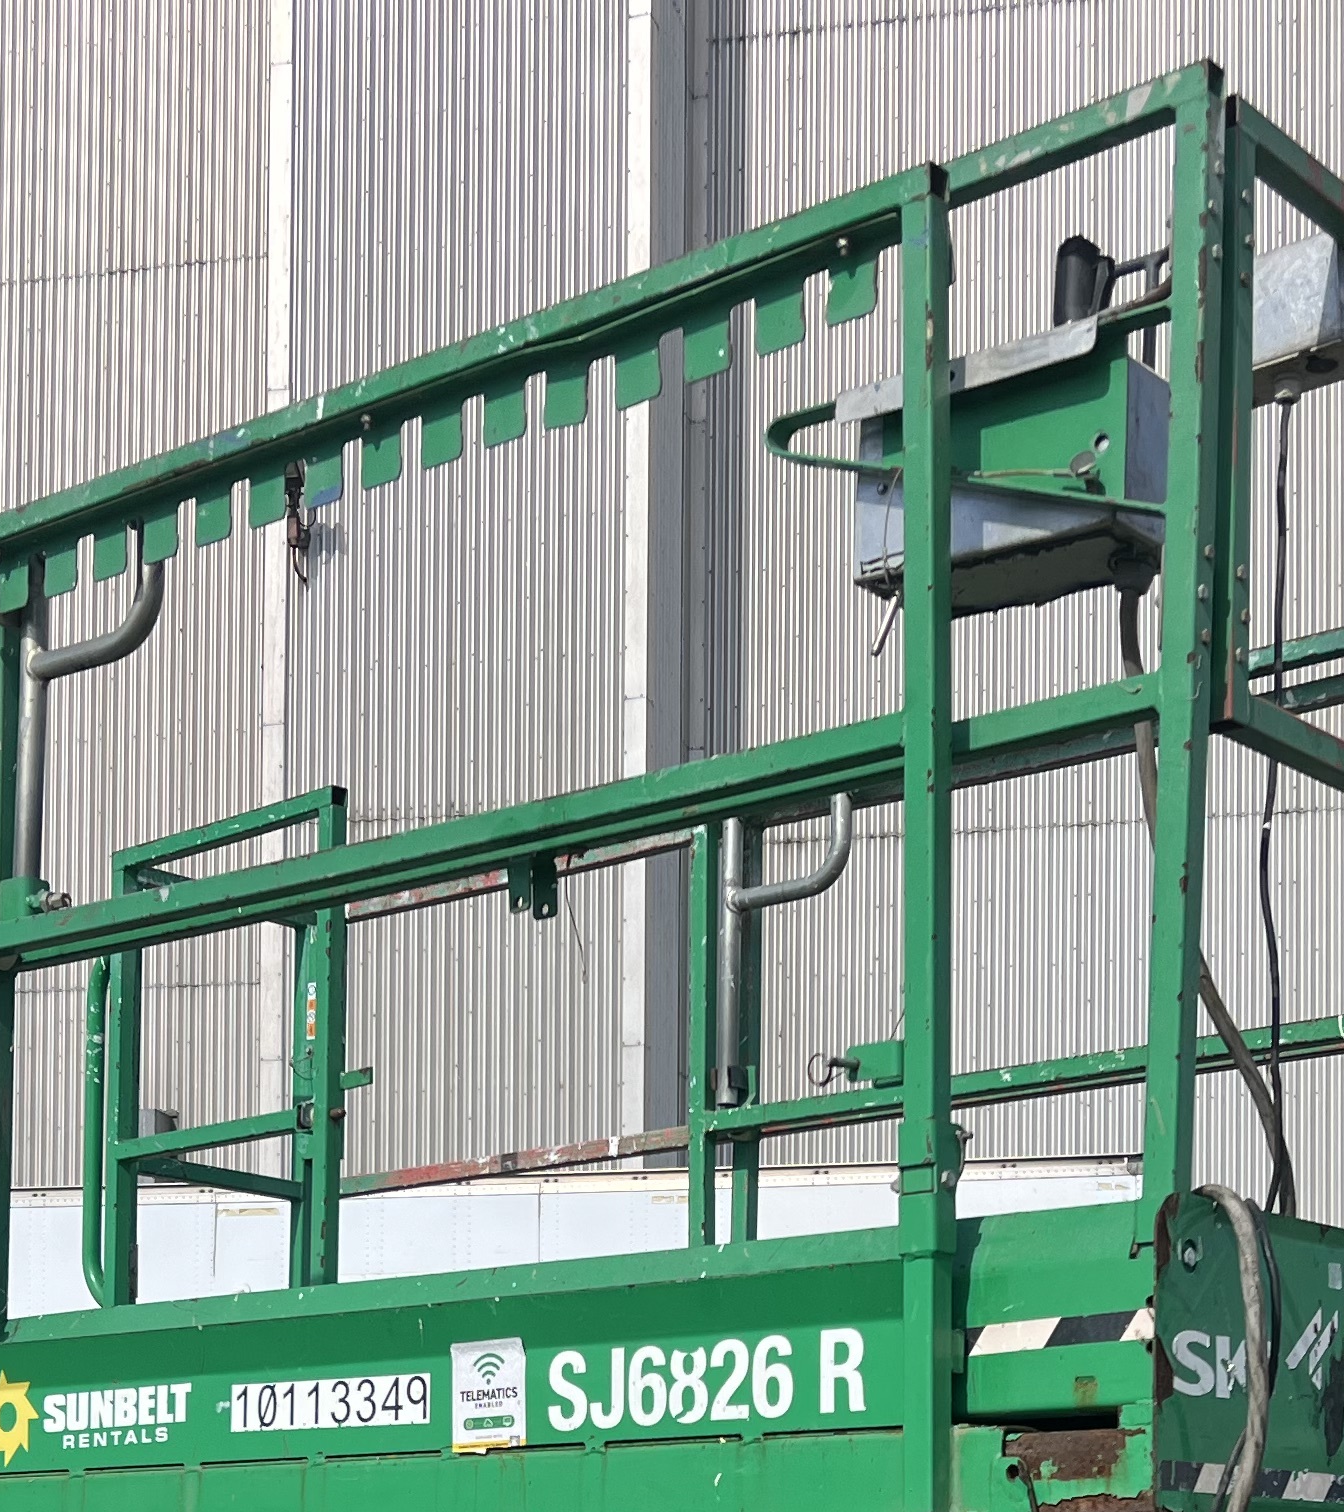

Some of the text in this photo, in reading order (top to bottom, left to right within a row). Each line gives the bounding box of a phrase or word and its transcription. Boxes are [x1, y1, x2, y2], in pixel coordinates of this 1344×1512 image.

[460, 1387, 518, 1402] TELEMATICS
[547, 1328, 866, 1431] SJ6826 R
[43, 1382, 192, 1433] SUNBELT
[236, 1375, 428, 1428] 10113349
[475, 1401, 503, 1409] ENABLED
[63, 1427, 168, 1450] RENTALS
